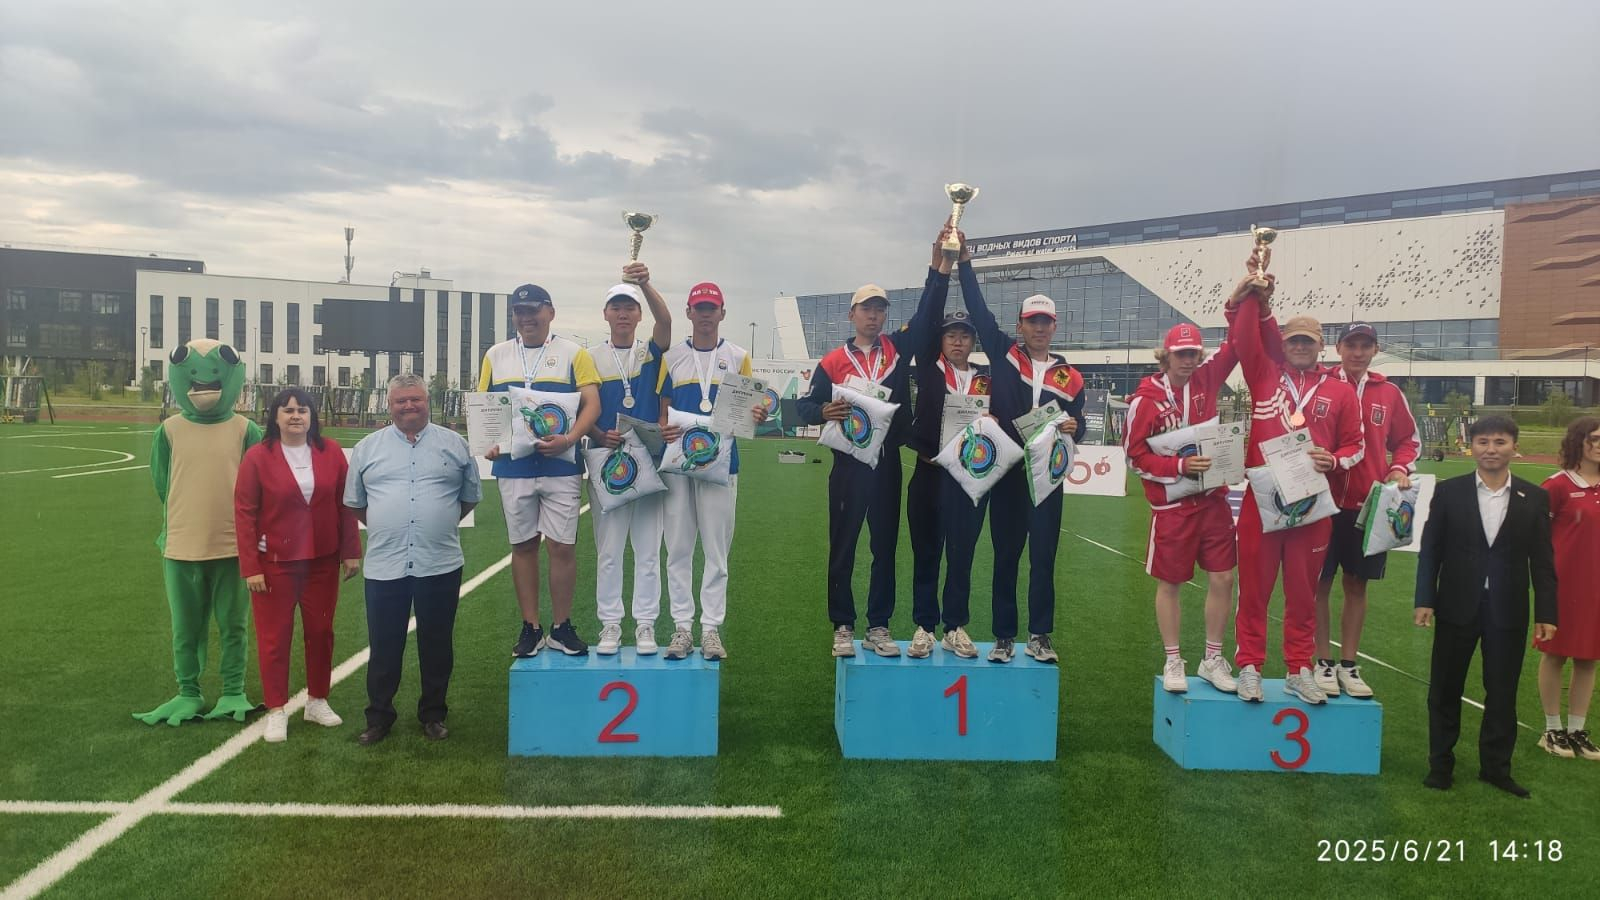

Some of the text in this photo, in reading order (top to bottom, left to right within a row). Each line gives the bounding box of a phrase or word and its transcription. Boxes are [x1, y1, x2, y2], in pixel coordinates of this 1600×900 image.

[977, 241, 1011, 252] ВОДНЫХ
[1013, 238, 1041, 249] ВИДОВ
[1043, 235, 1076, 245] СПОРТА
[1036, 247, 1054, 256] water
[597, 681, 640, 743] 2
[943, 675, 968, 736] 1
[1269, 708, 1311, 769] 3
